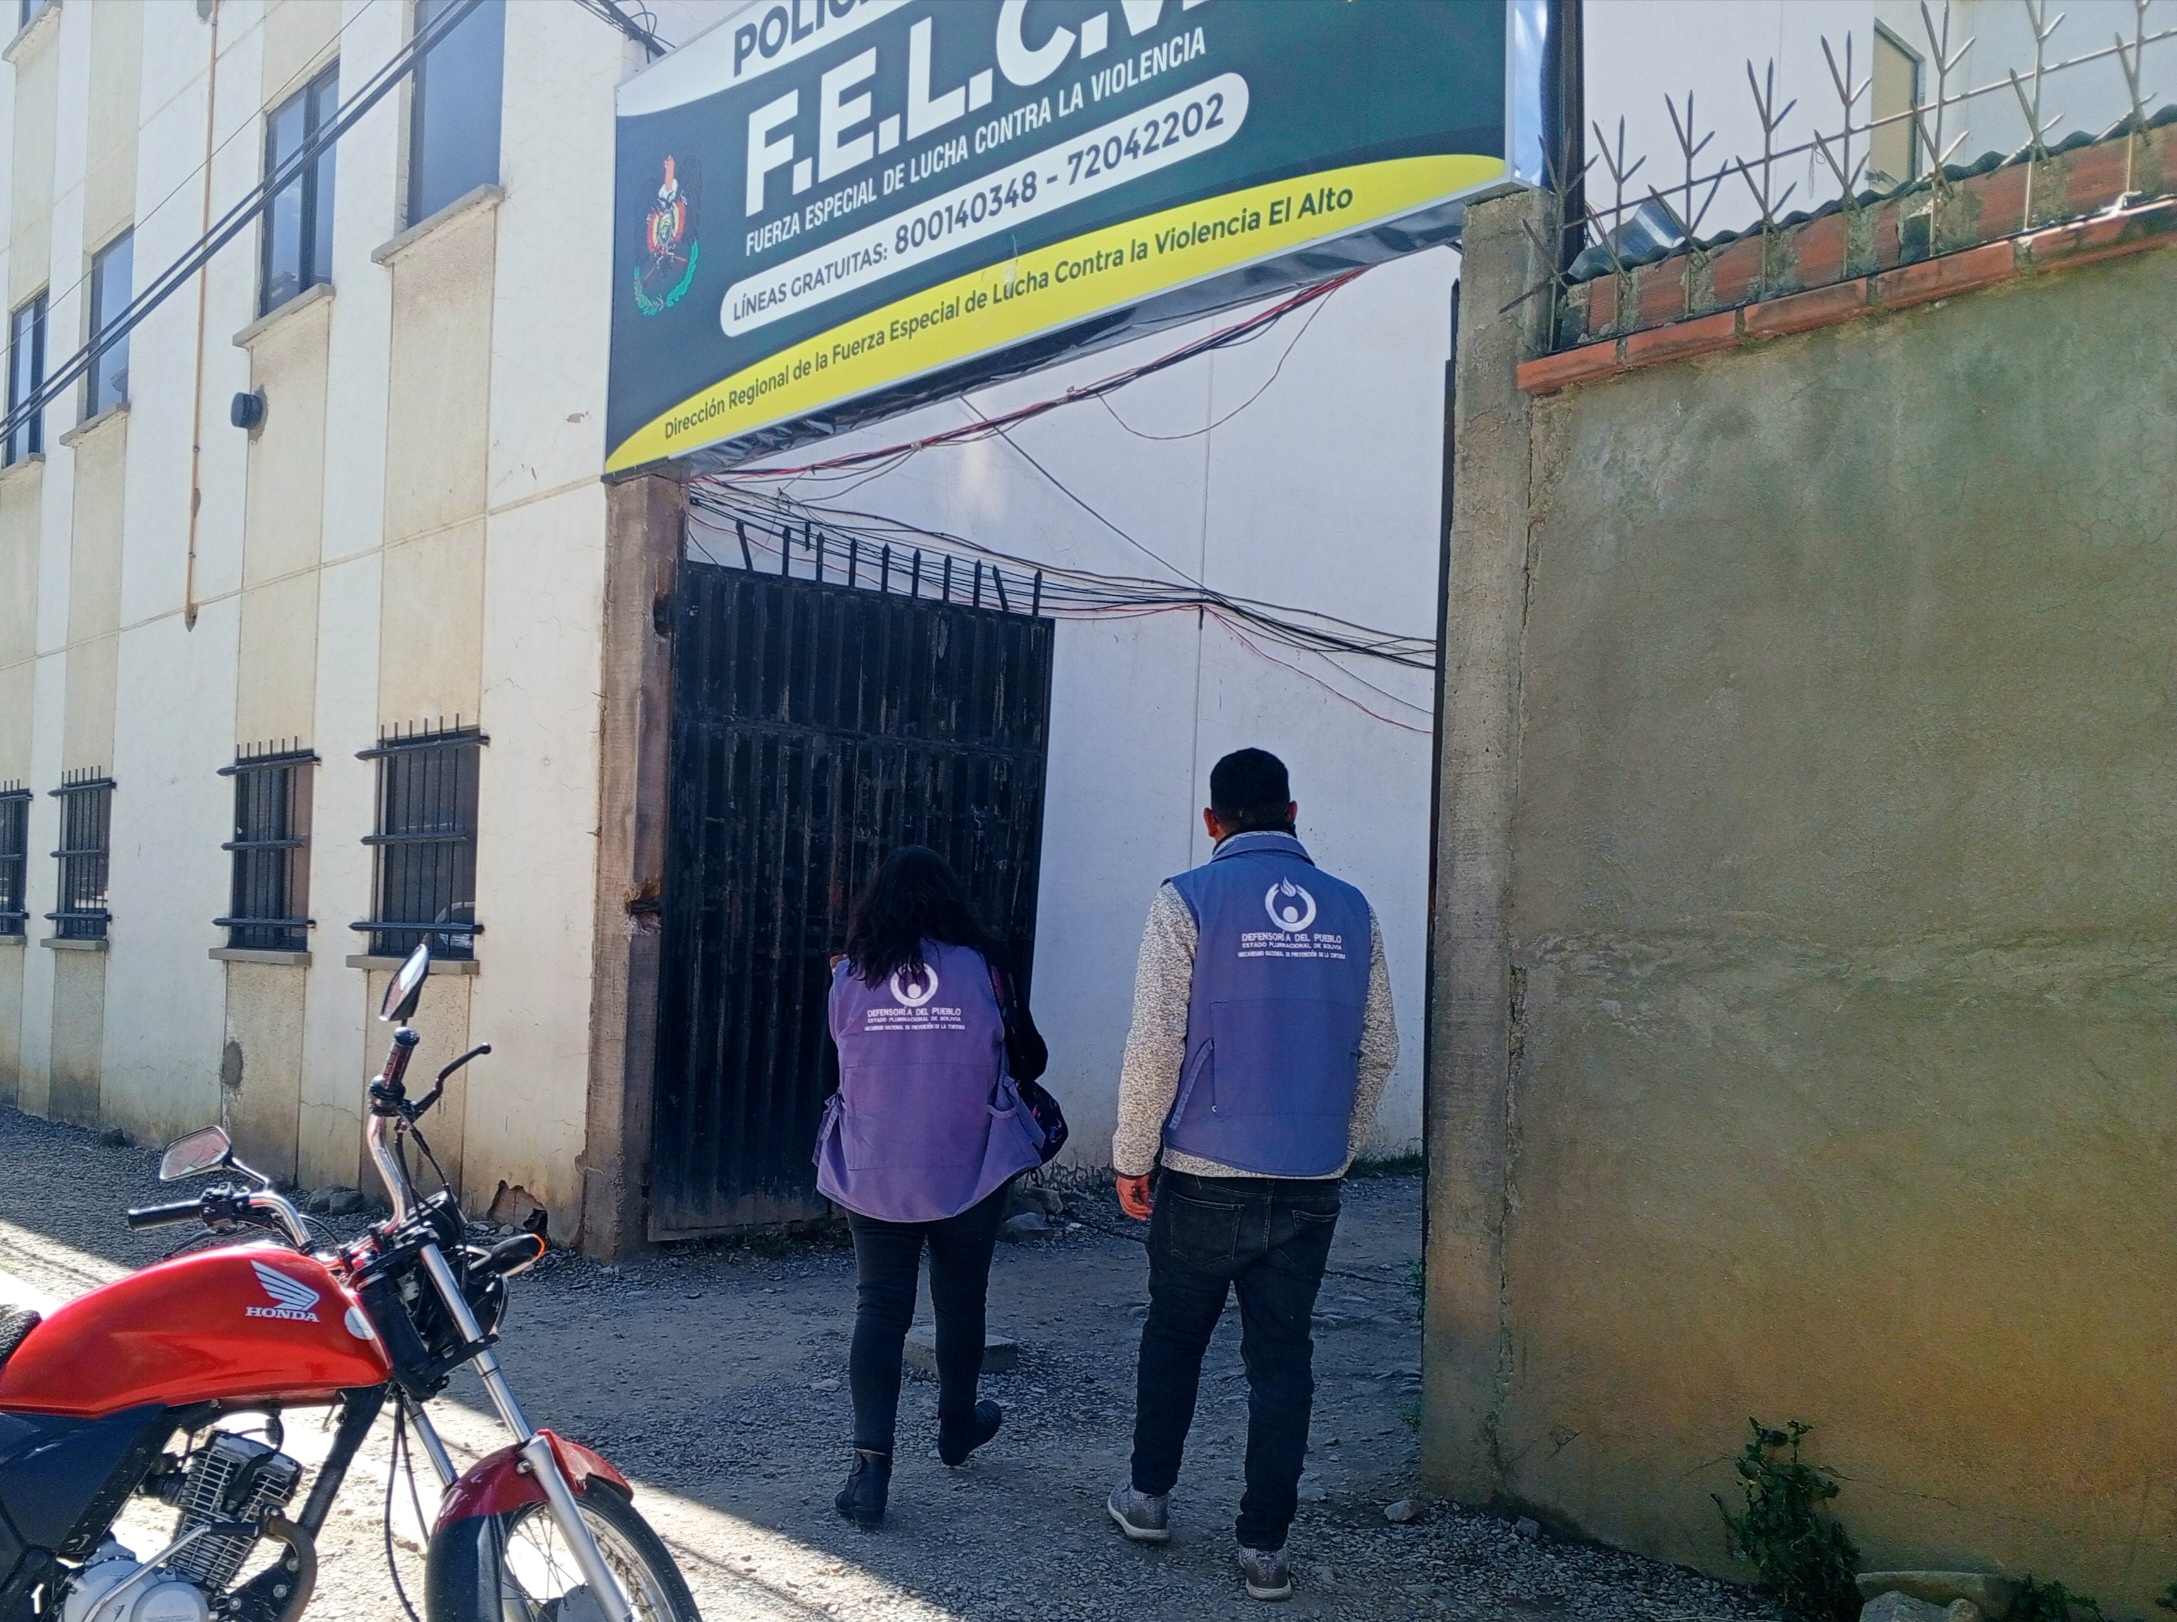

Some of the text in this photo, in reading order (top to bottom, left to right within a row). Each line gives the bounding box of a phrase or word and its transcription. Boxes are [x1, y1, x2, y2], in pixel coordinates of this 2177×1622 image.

[734, 0, 869, 78] POLI
[745, 26, 1206, 257] FUERZA ESPECIAL DE LUCHA CONTRA LA VIOLENCIA
[733, 92, 1225, 322] LÍNEAS GRATUITAS: 800140348 - 72042202
[665, 187, 1354, 441] Dirección Regional de la Fuerza Especial de Lucha Contra la Violencia El Alto
[1241, 930, 1342, 944] DEFENSORÍA DEL PUEBLO
[866, 1005, 962, 1018] DEFENSORÍA DEL PUEBLO
[867, 1016, 887, 1024] ESTADO
[244, 1306, 320, 1323] HONDA
